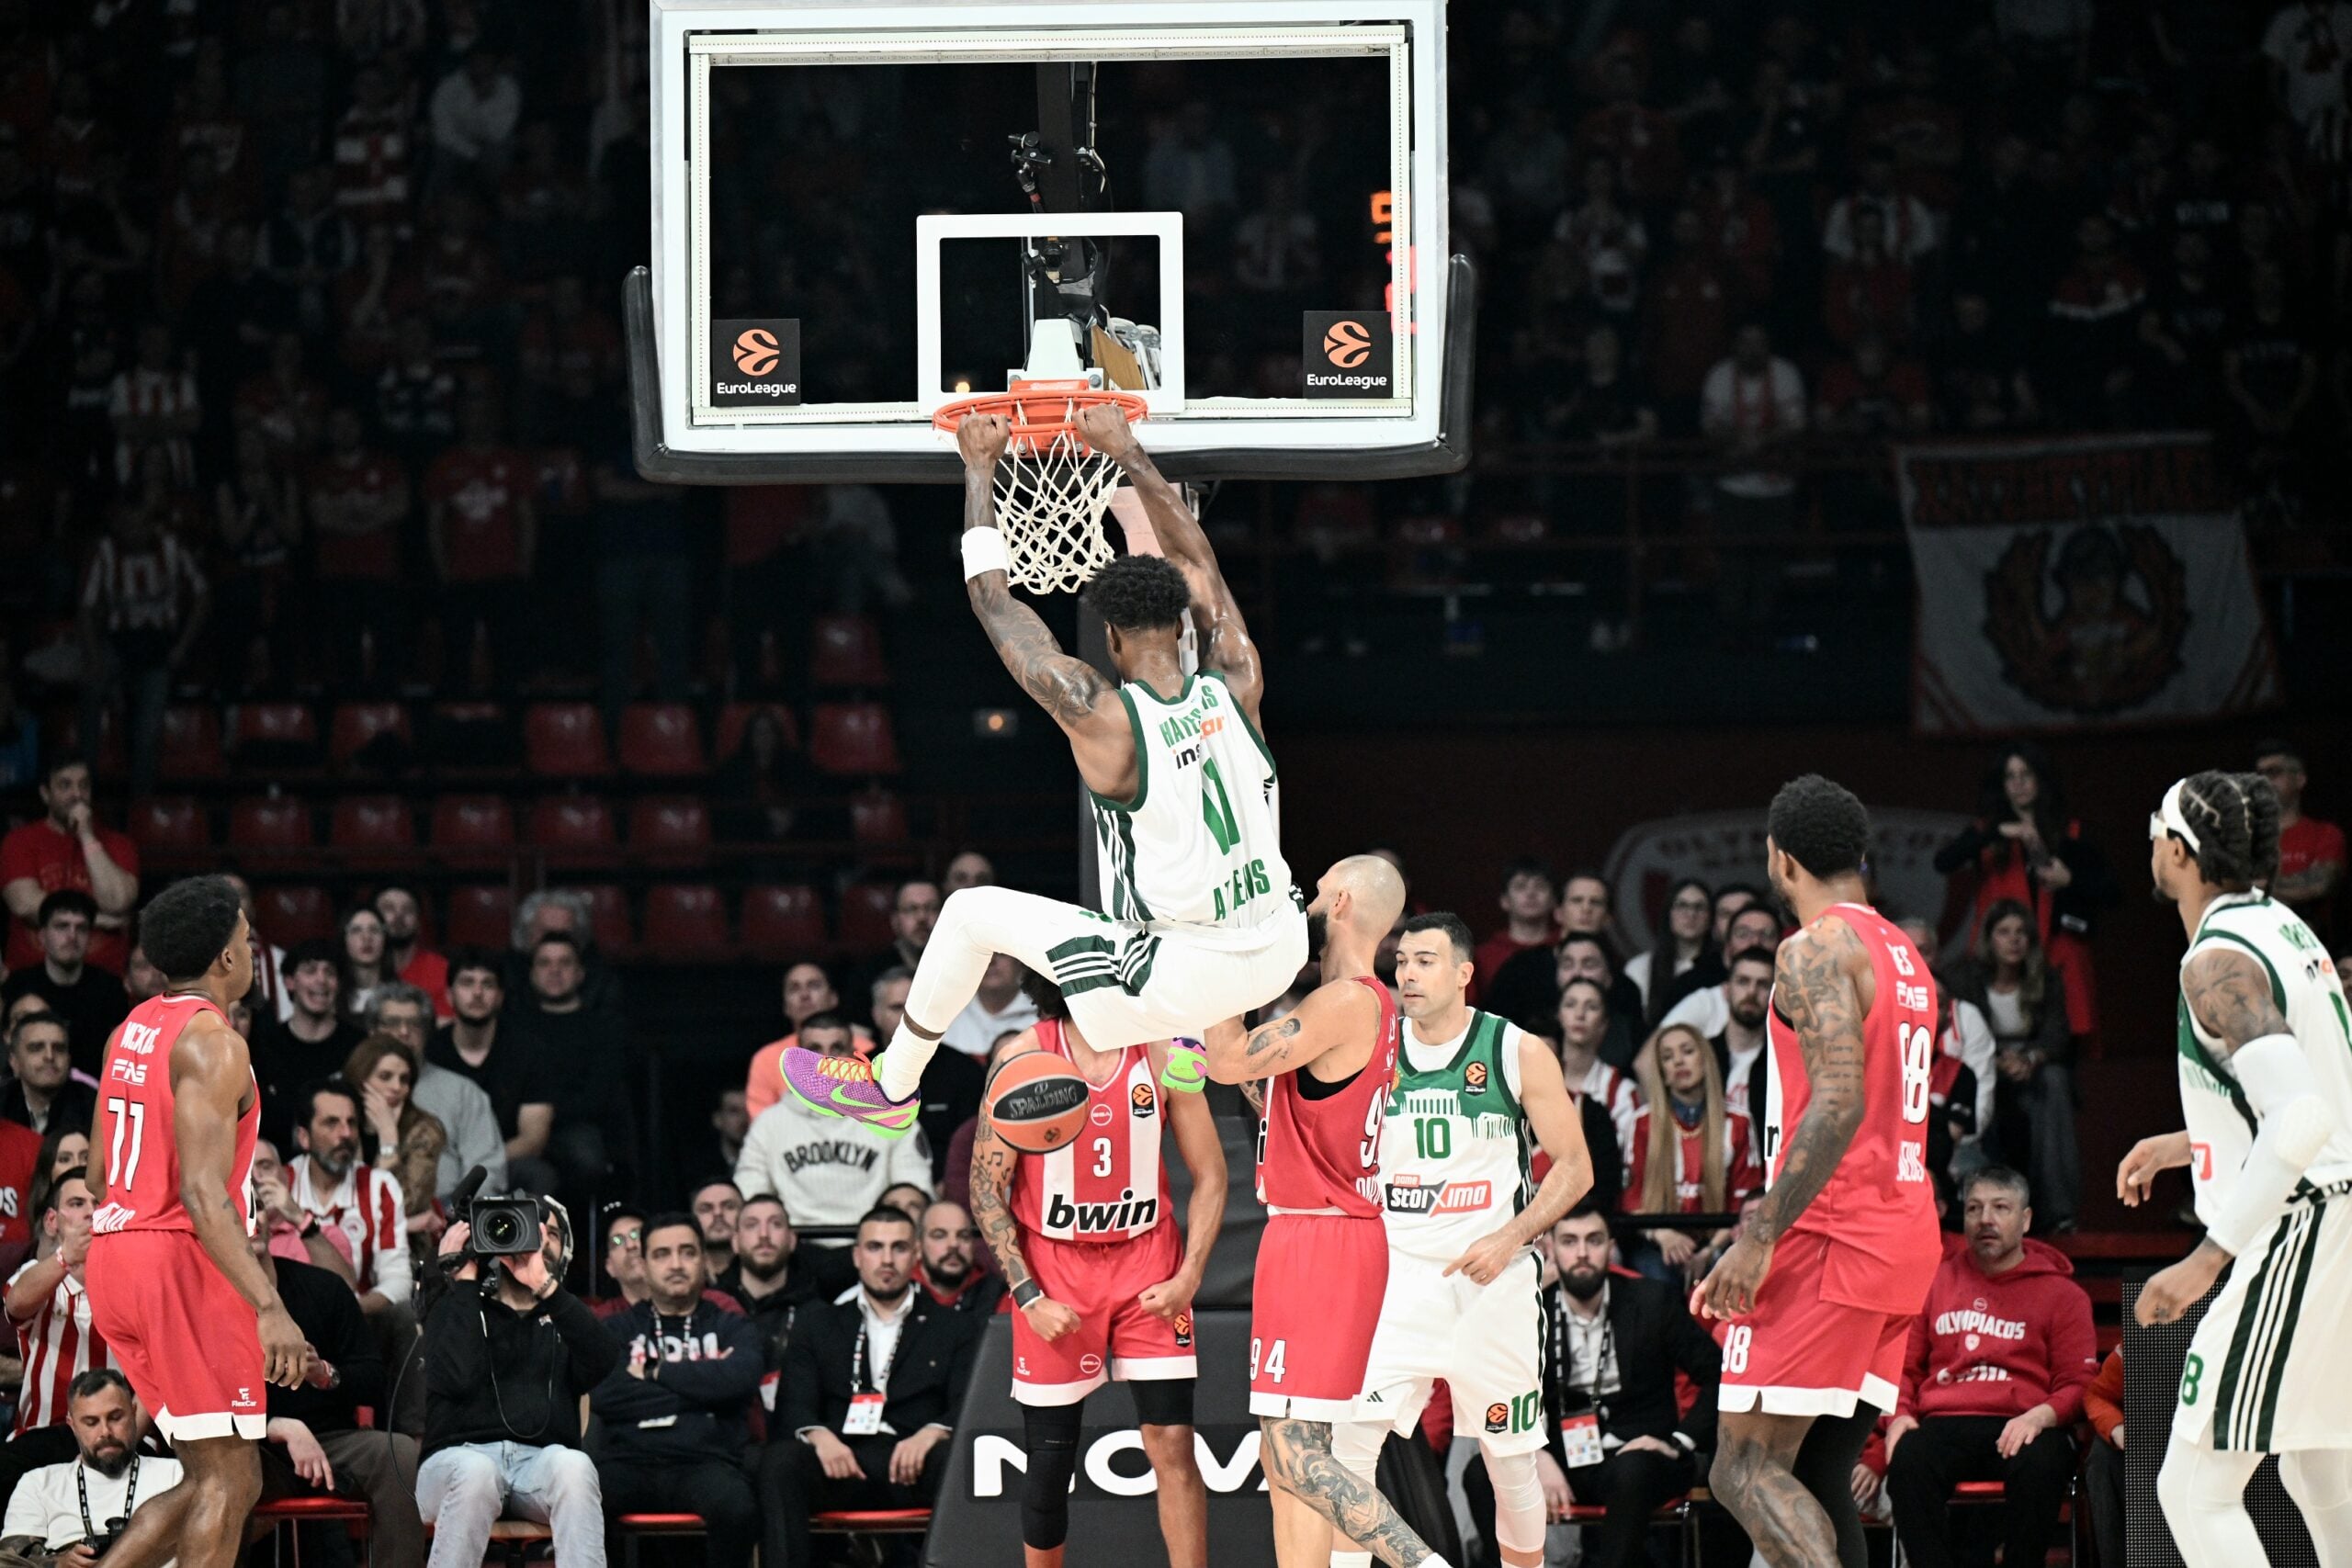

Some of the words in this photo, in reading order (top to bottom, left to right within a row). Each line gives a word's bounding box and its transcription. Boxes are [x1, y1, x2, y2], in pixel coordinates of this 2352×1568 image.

[717, 381, 797, 397] EuroLeague
[1306, 374, 1387, 389] EuroLeague
[1010, 1084, 1078, 1119] SPALDING
[784, 1141, 879, 1174] BROOKLYN
[1093, 1137, 1112, 1178] 3
[1414, 1118, 1451, 1159] 10
[1046, 1190, 1157, 1232] bwin
[1250, 1337, 1286, 1383] 94
[1511, 1389, 1539, 1434] 10
[974, 1429, 1271, 1497] NOV
